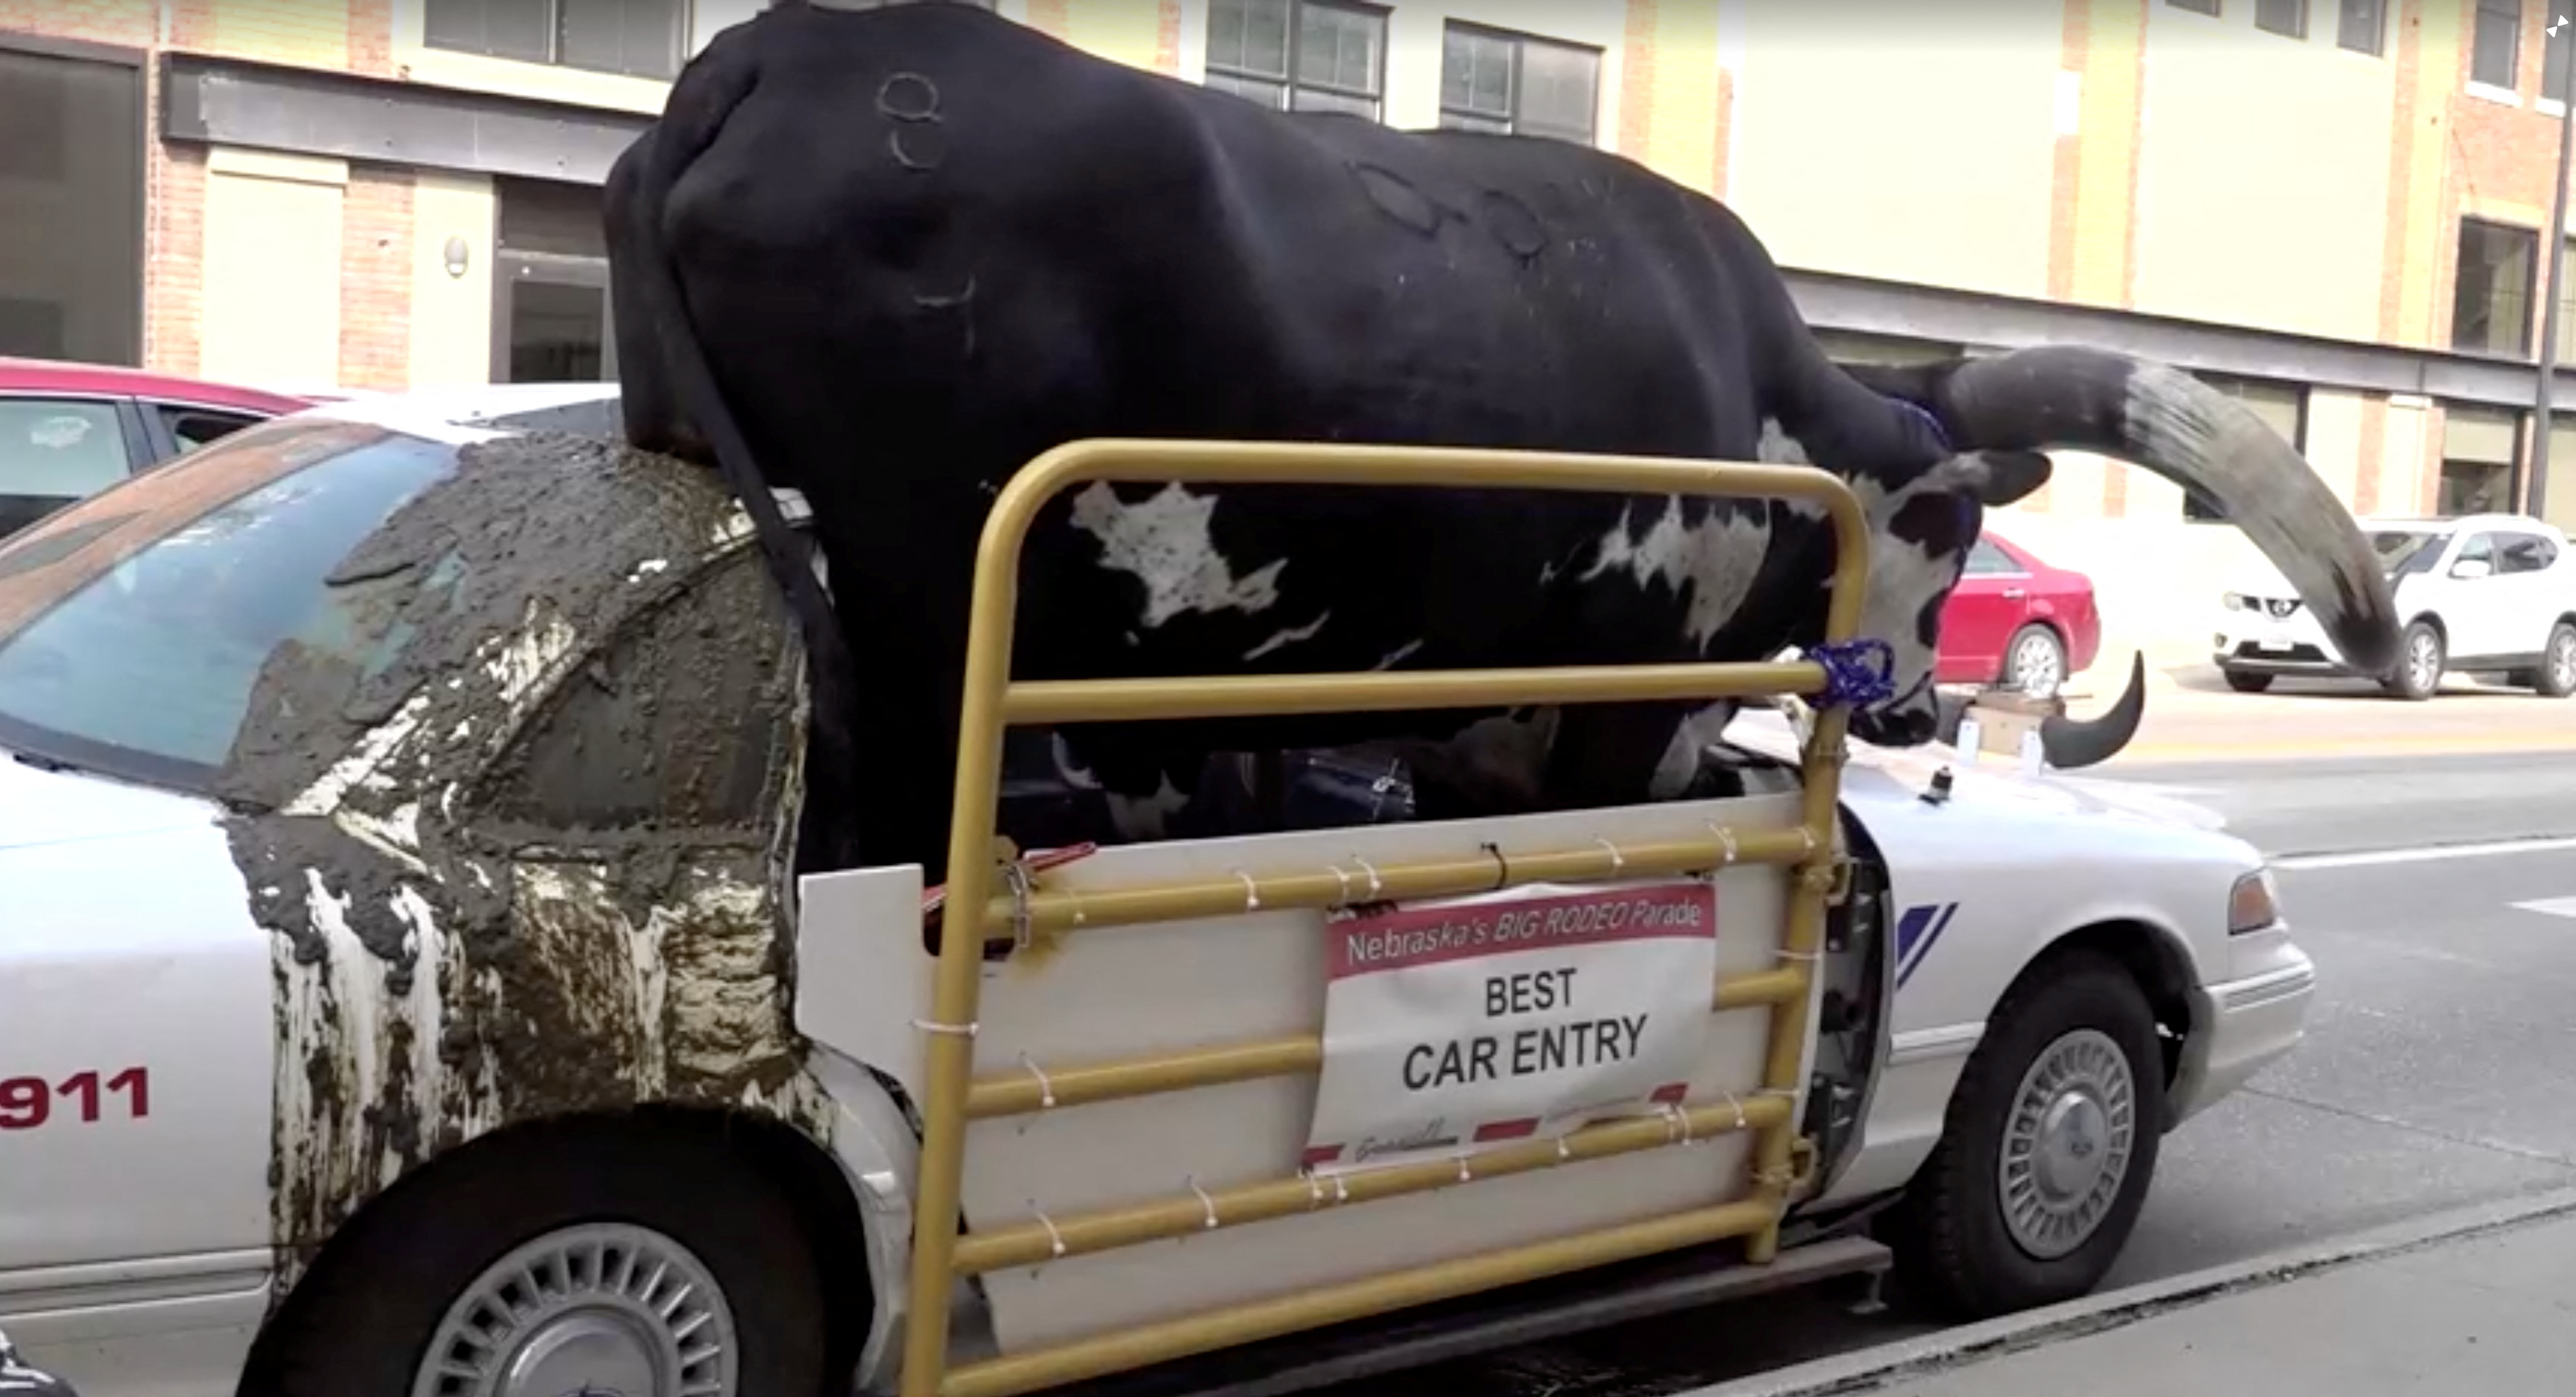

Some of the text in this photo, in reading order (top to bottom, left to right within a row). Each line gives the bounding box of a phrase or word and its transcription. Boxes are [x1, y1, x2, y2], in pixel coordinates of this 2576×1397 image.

[1347, 898, 1701, 965] Nebraska's BIG RODEO Parade
[1486, 968, 1577, 1017] BEST
[1402, 1014, 1649, 1091] CAR ENTRY
[0, 1067, 148, 1129] 911
